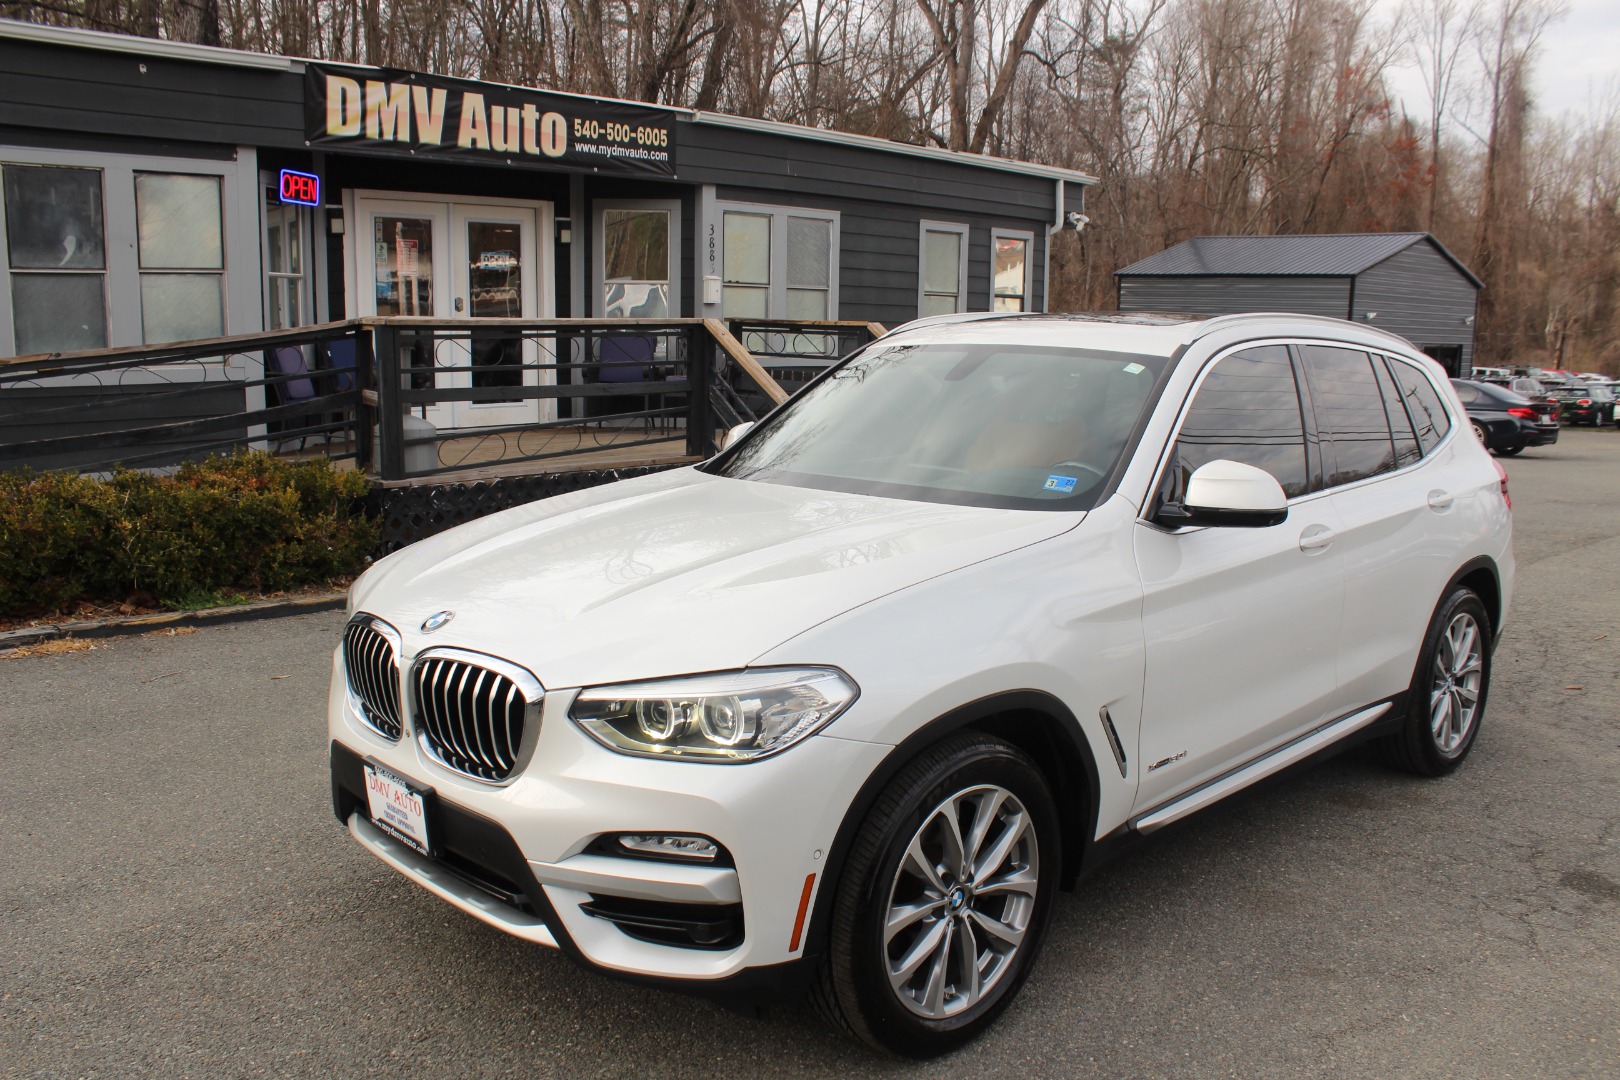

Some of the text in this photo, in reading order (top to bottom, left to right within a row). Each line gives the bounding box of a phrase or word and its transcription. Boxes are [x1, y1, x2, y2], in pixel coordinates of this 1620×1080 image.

[326, 74, 567, 157] DMV Auto
[574, 118, 668, 147] 540-500-6005
[574, 142, 668, 161] www.mydmvauto.com
[282, 173, 317, 201] OPEN
[369, 775, 422, 817] DMV AUTO
